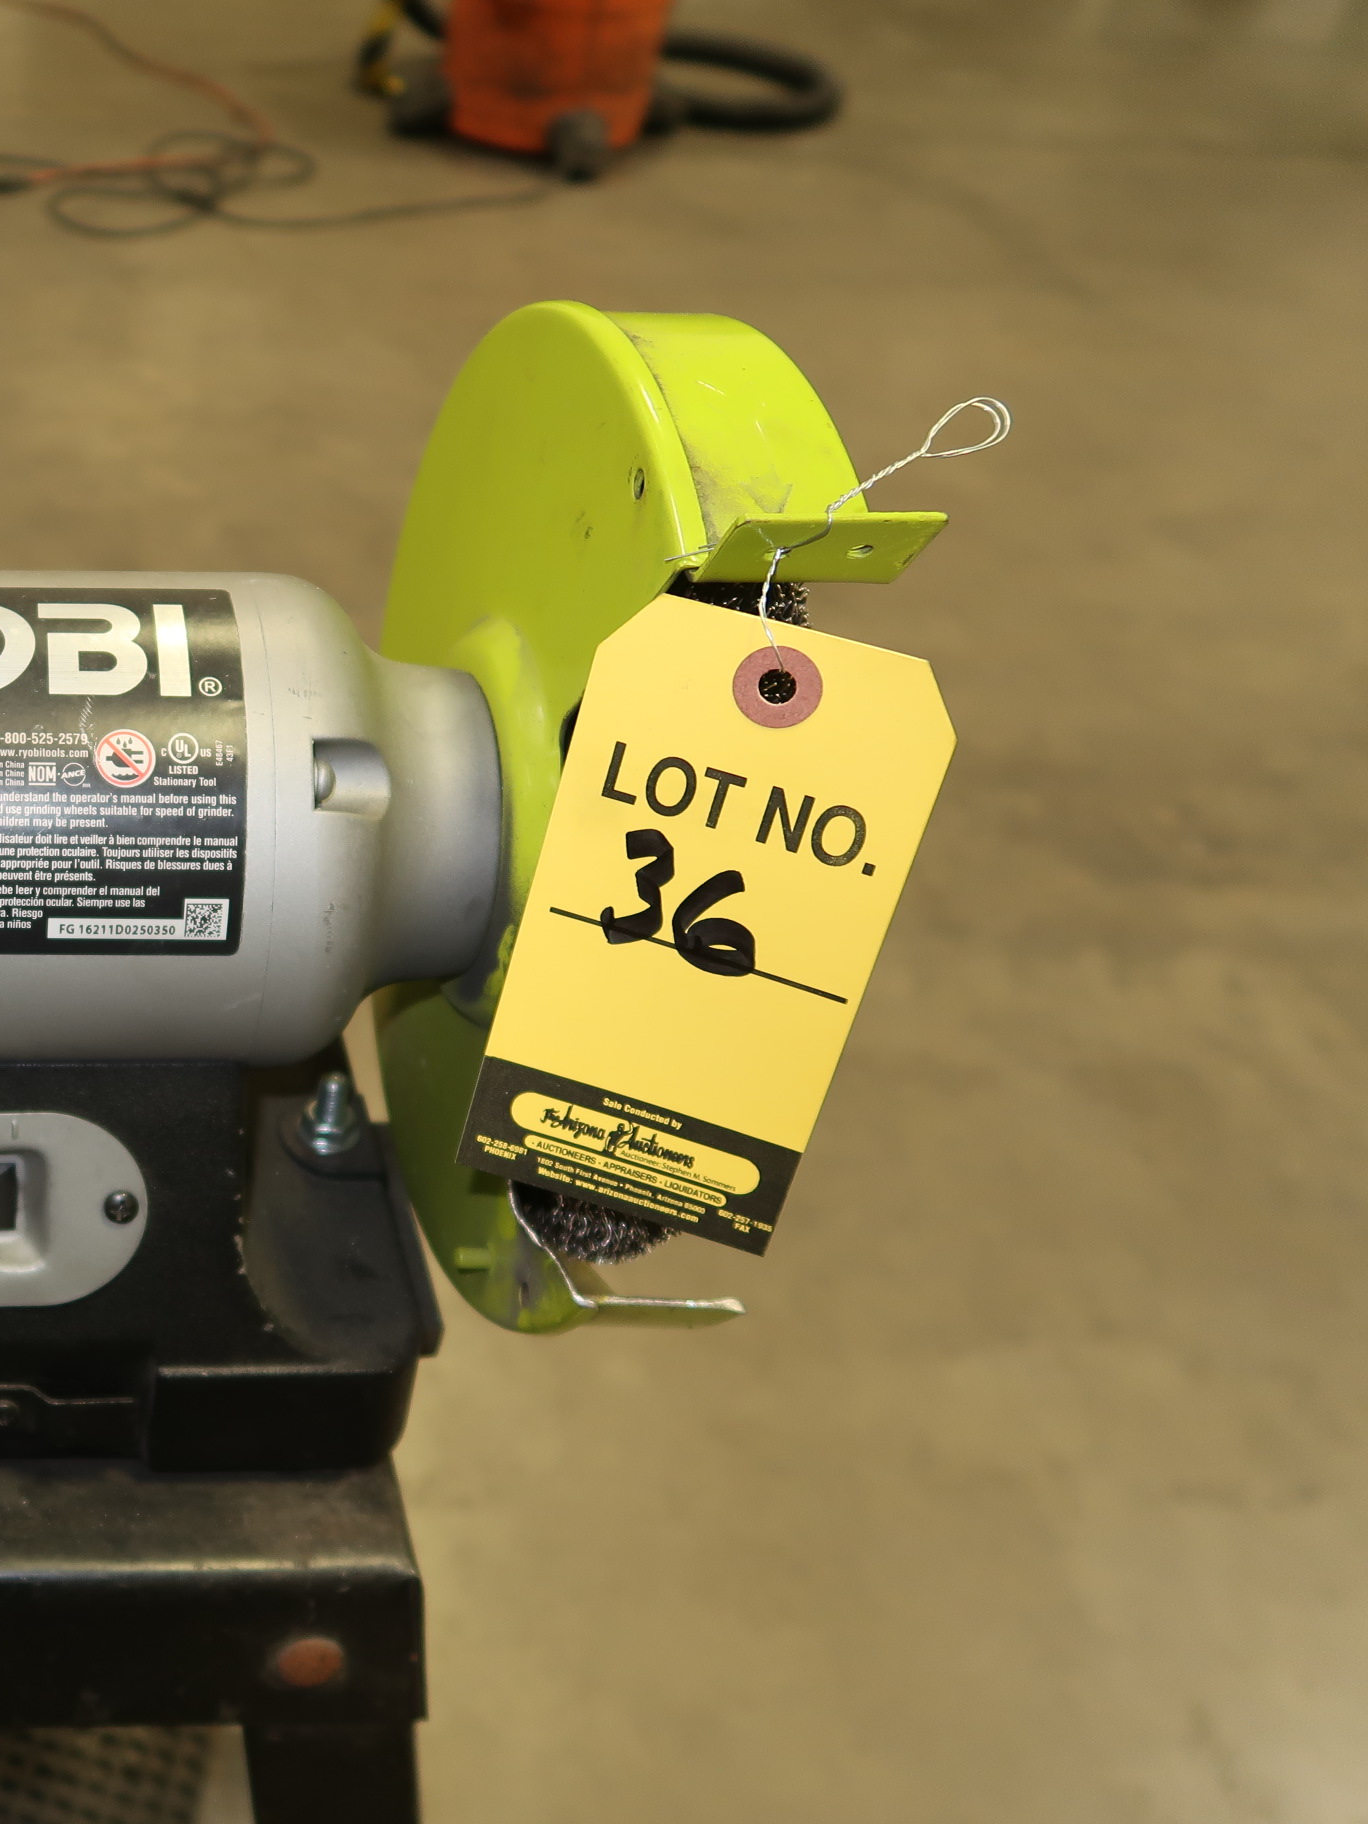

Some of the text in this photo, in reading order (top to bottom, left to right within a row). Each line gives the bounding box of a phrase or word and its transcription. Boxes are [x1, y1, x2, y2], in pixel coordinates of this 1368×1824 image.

[200, 749, 211, 757] US
[29, 766, 56, 781] NOM
[61, 769, 86, 779] ANCE
[169, 766, 198, 774] LISTED
[154, 777, 216, 788] Stationary Tool
[53, 793, 67, 802] the
[70, 793, 117, 804] operator's
[121, 794, 155, 803] manual
[159, 794, 188, 804] before
[192, 795, 216, 806] using
[218, 795, 236, 804] this
[601, 742, 876, 876] LOT NO.
[1, 858, 49, 869] appropriée
[52, 861, 72, 871] pour
[74, 859, 102, 869] l'outil.
[106, 860, 141, 871] Risques
[144, 860, 155, 869] de
[158, 860, 200, 870] blessures
[203, 861, 224, 870] dues
[227, 861, 232, 870] à
[600, 829, 755, 977] 36
[12, 909, 43, 919] Riesgo
[60, 924, 175, 935] FG 16211D0250350
[602, 1098, 683, 1131] Sale Conducted by
[483, 1145, 517, 1161] PHOENIX
[536, 1140, 723, 1205] AUCTIONEERS APPRAISERS LIQUIDATORS
[537, 1166, 574, 1184] Website:
[620, 1150, 662, 1168] Auctioneer:
[661, 1163, 692, 1178] Stephen
[702, 1176, 736, 1191] Sommers
[553, 1162, 575, 1174] South
[575, 1169, 592, 1179] First
[656, 1194, 683, 1207] Arizona
[733, 1222, 751, 1234] FAX
